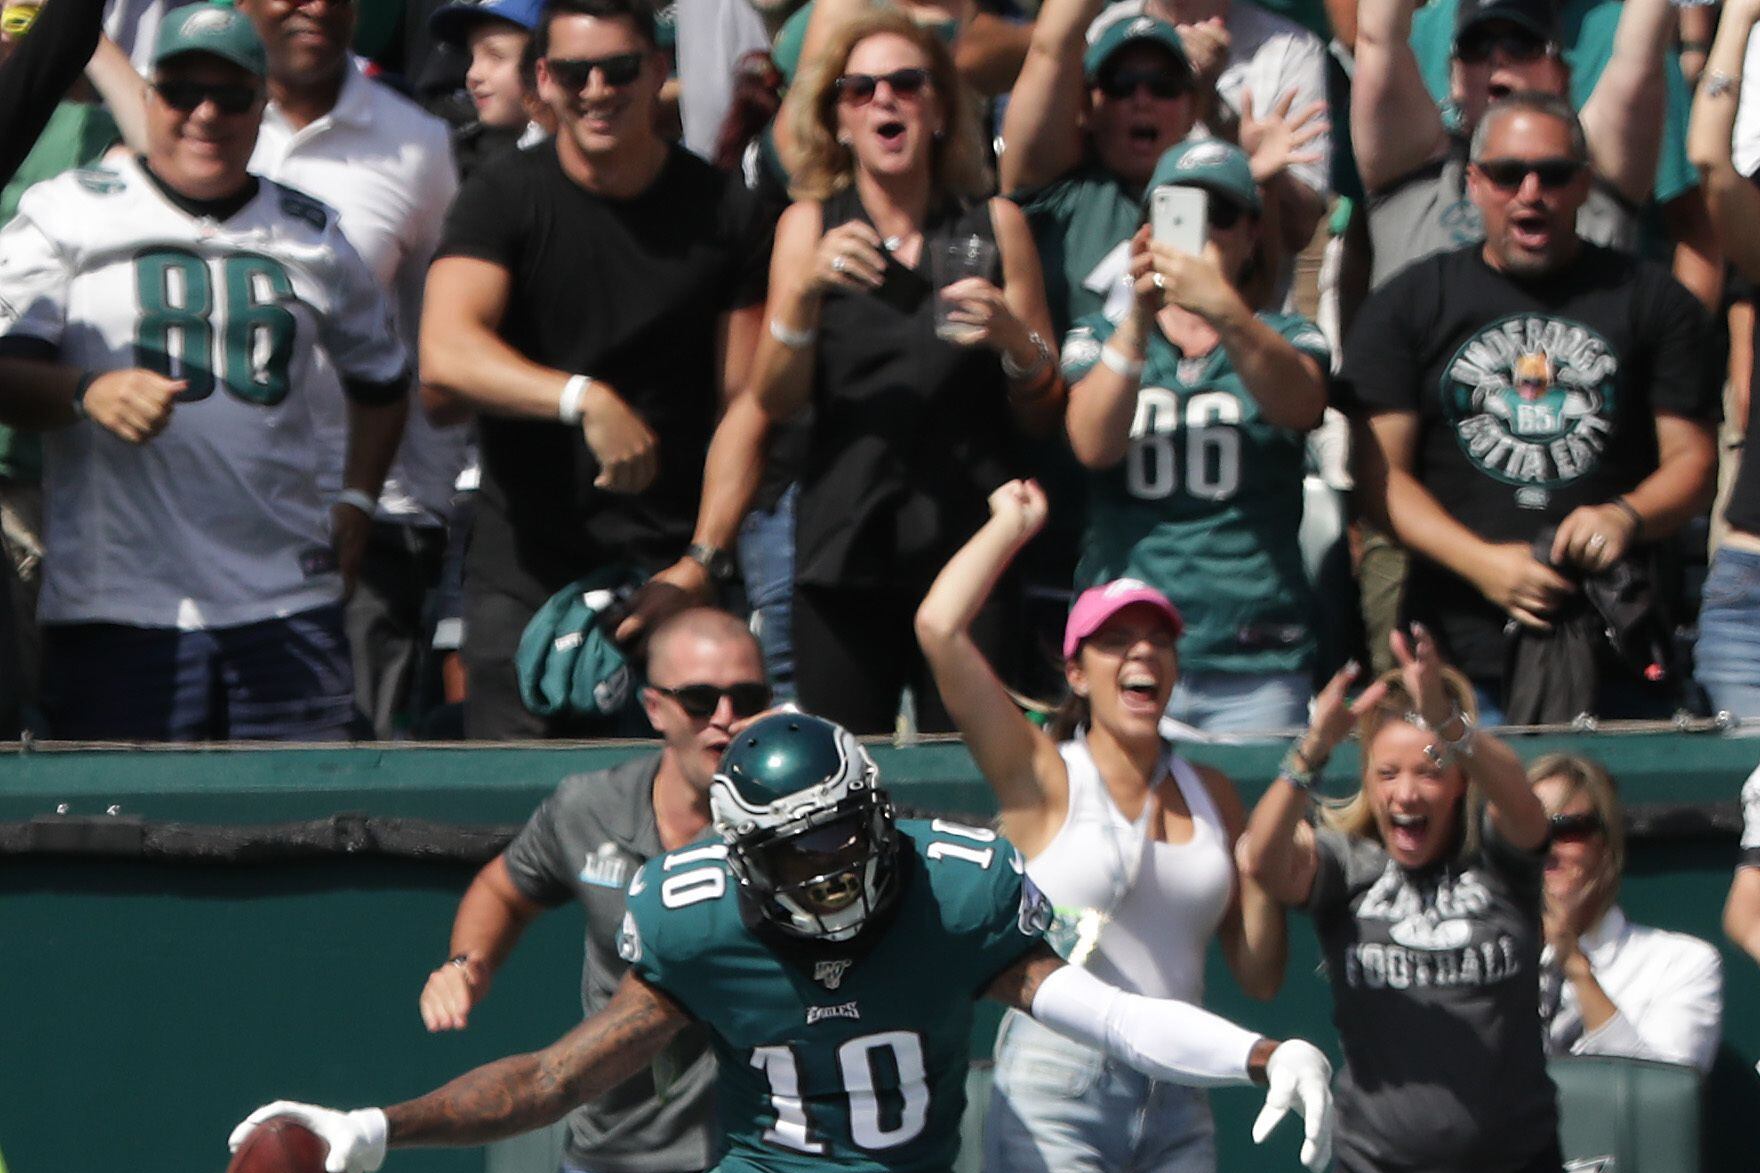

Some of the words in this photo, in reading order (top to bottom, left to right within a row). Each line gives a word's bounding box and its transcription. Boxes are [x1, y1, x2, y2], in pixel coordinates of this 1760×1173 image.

[134, 246, 297, 406] 86
[1127, 387, 1241, 499] 86
[749, 1030, 932, 1156] 10
